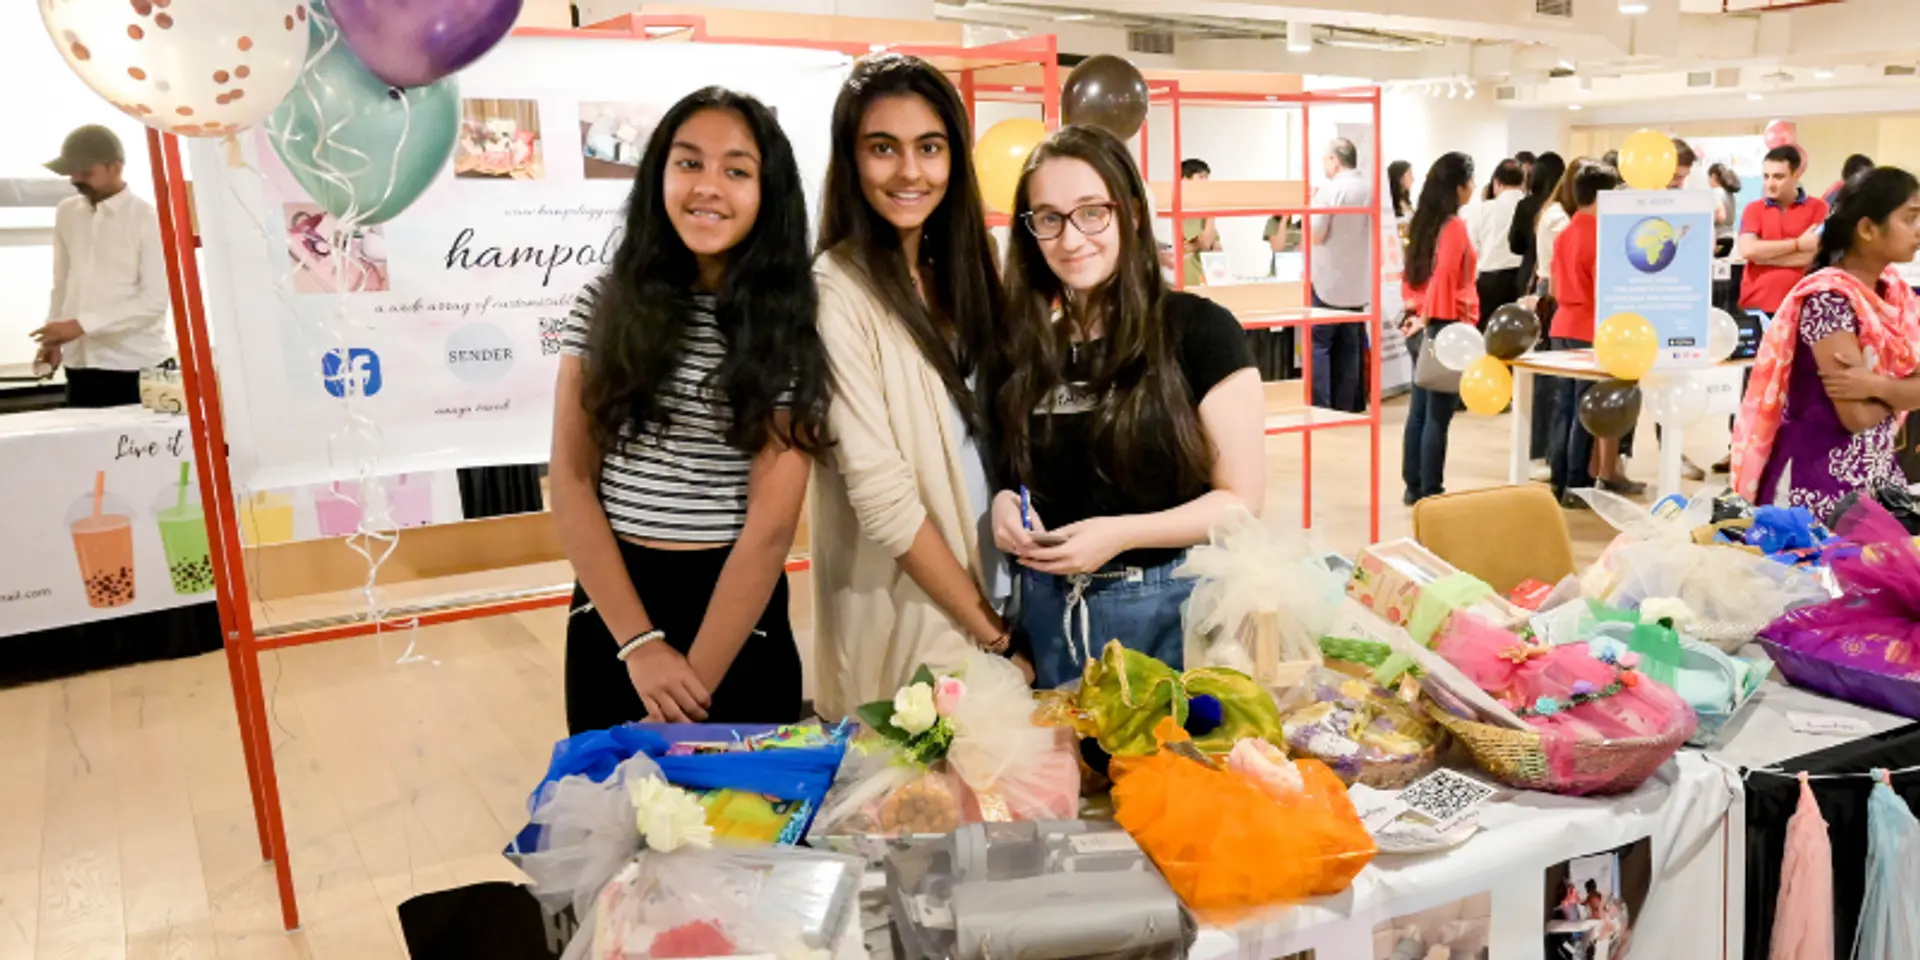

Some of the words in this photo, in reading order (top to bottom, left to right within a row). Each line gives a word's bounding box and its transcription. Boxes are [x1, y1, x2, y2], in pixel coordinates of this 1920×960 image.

[448, 347, 513, 364] SENDER
[115, 434, 159, 460] Live
[166, 429, 183, 457] it
